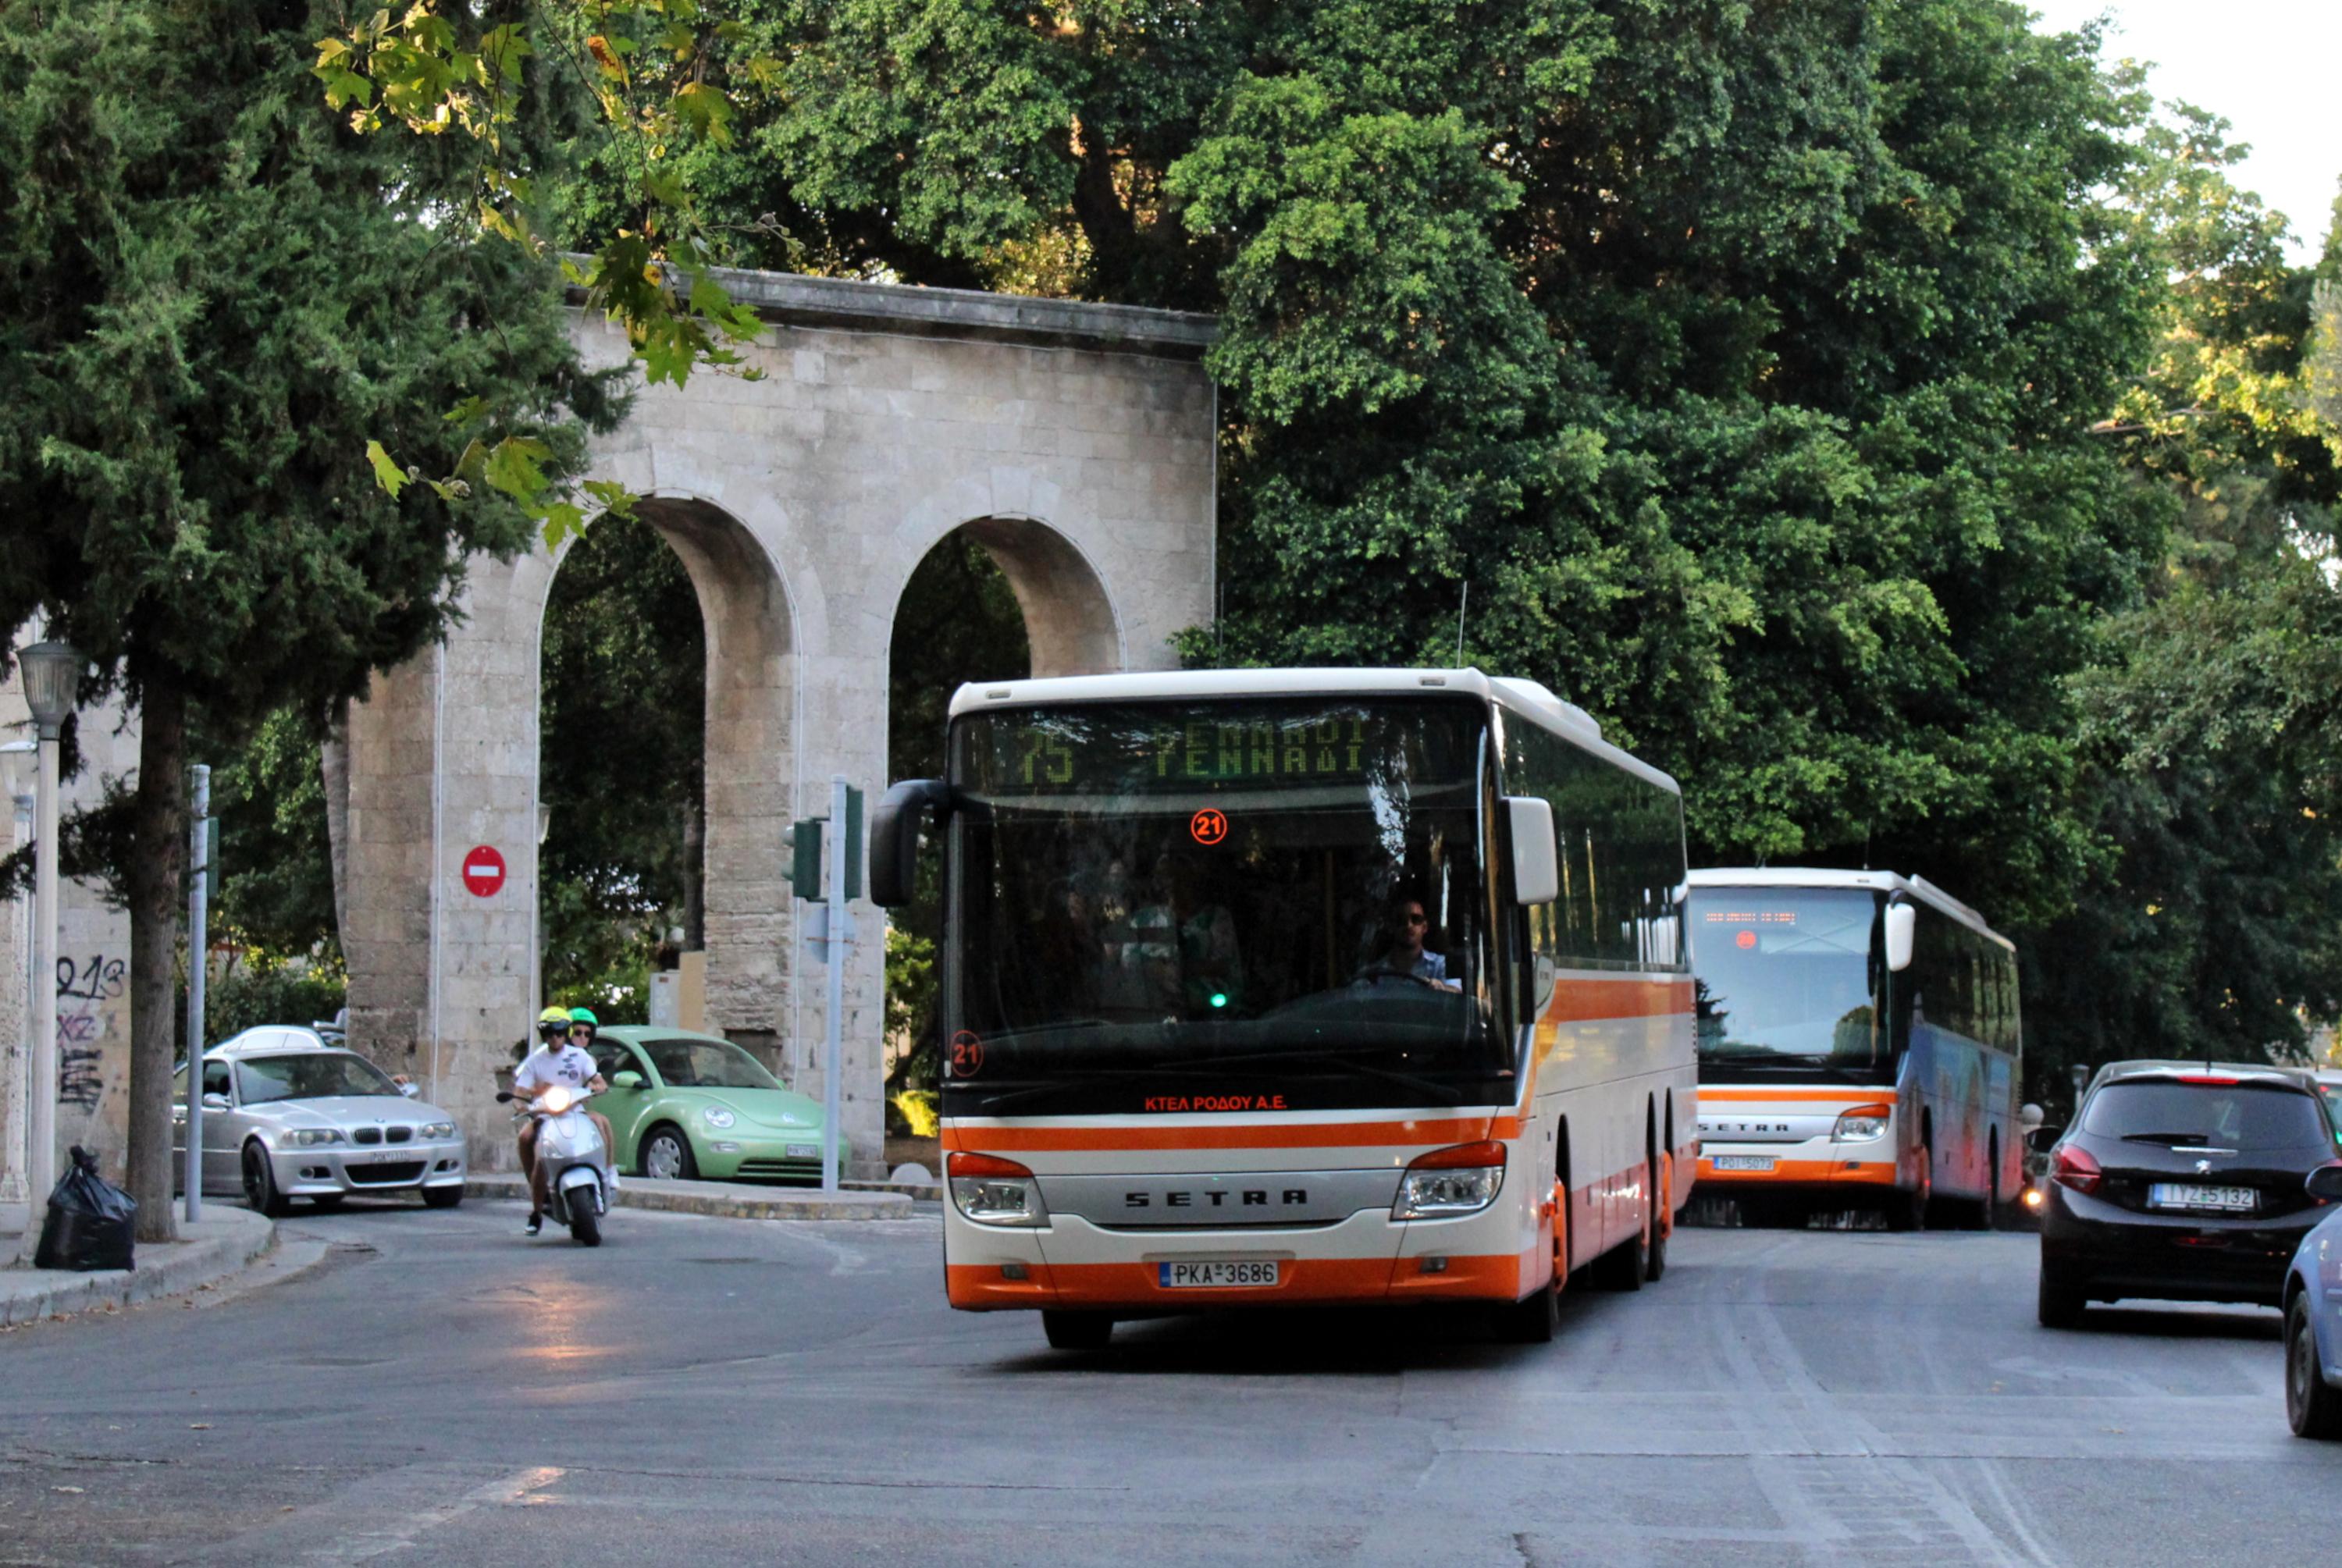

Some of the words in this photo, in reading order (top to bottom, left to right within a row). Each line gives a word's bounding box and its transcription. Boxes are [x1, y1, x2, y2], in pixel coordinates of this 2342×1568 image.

[1197, 816, 1220, 835] 21
[953, 1044, 978, 1064] 21
[1145, 1097, 1189, 1111] ΚΤΕΛ
[1194, 1096, 1251, 1111] ΡΟΔΟΥ
[1697, 1123, 1789, 1132] SETRA
[1125, 1189, 1308, 1207] SETRA
